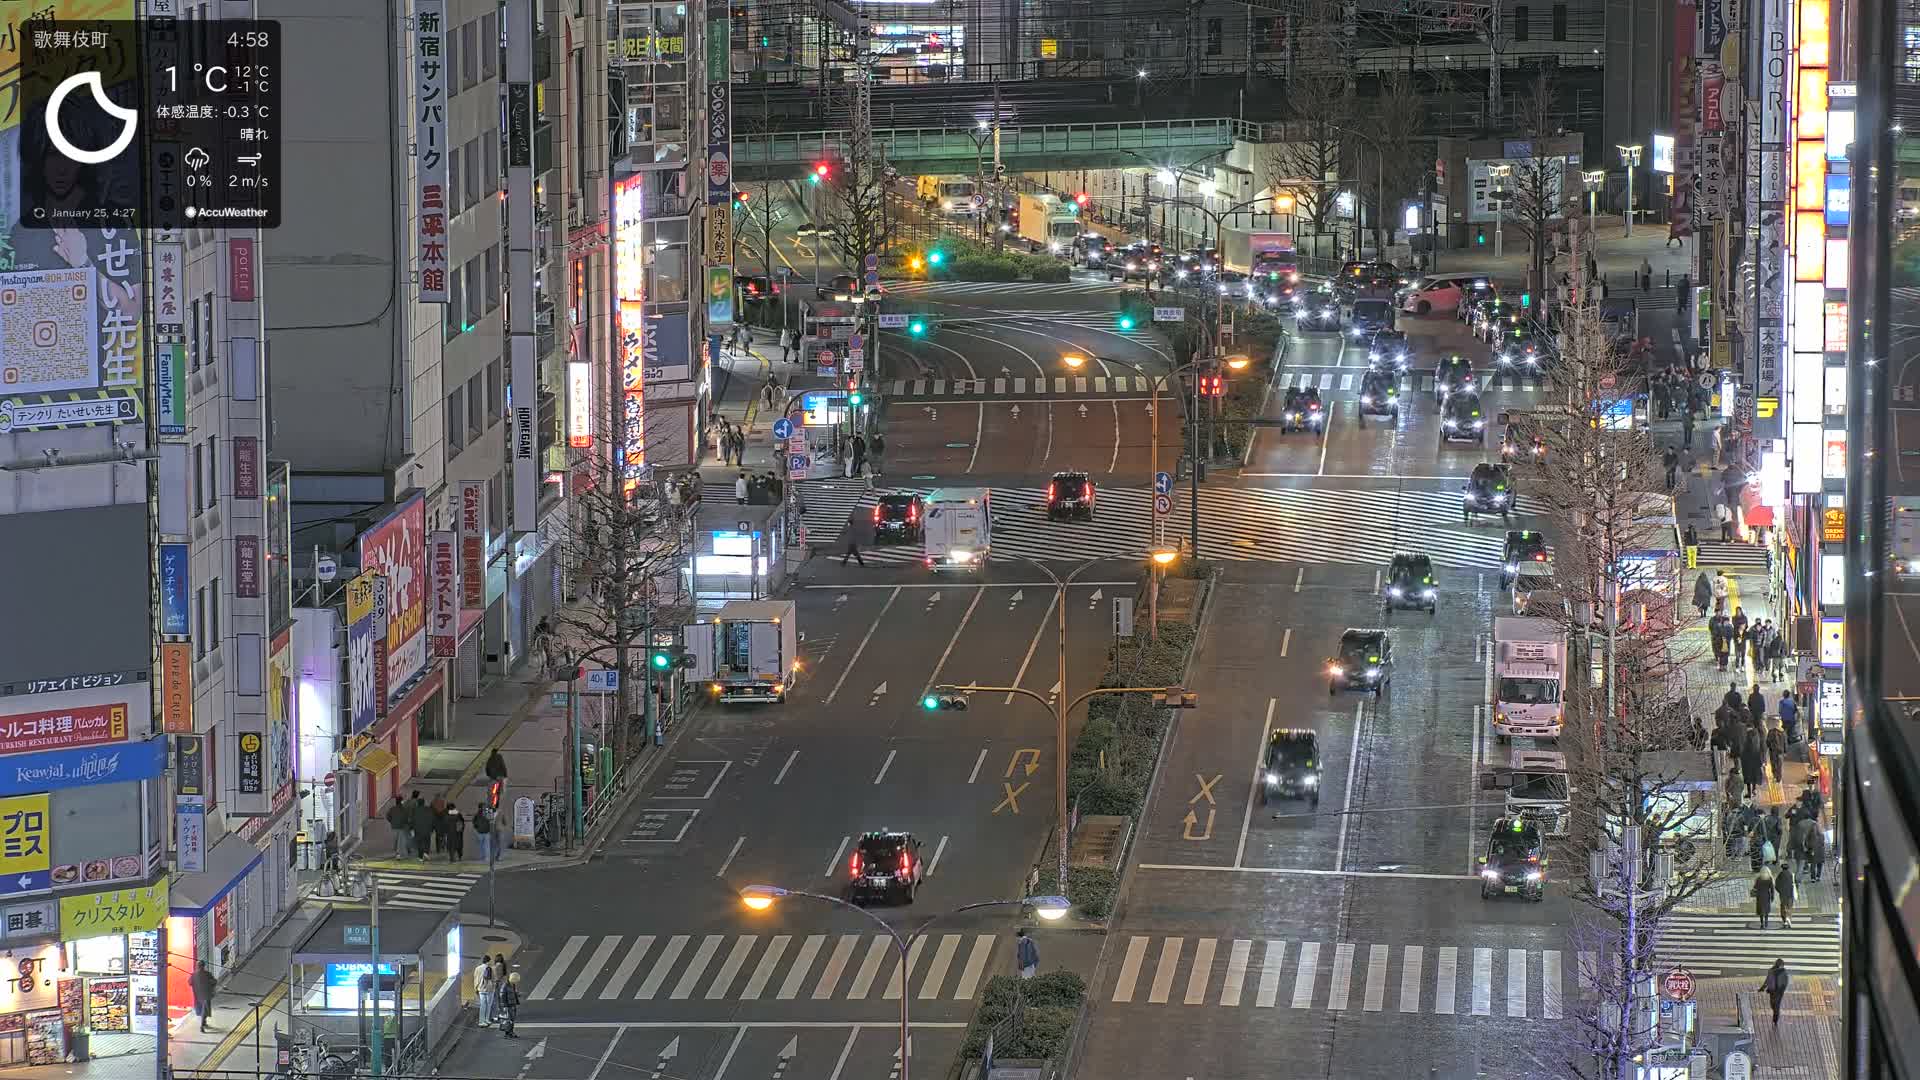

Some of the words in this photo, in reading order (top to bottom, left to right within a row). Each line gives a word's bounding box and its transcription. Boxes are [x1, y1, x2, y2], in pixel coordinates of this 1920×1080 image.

[419, 12, 441, 170] 新宿サンパーク
[1708, 88, 1720, 120] アコム
[711, 87, 725, 138] もつなべ
[713, 208, 726, 263] 肉汁水餃子
[0, 275, 44, 288] Instagram
[1761, 330, 1775, 382] 大衆酒場
[160, 353, 173, 414] FamilyMart
[17, 409, 52, 422] テンクリ
[57, 405, 115, 420] たいせい先生
[517, 407, 530, 459] HOMEGAME
[464, 487, 475, 530] GAME
[165, 554, 176, 605] ゲウチャイ
[28, 677, 80, 693] リアエイド
[82, 673, 123, 688] ビジョン
[28, 734, 73, 747] RESTAURANT
[4, 810, 43, 836] プロ
[4, 835, 43, 858] ミス
[8, 911, 43, 931] 囲碁
[73, 903, 145, 927] クリスタル
[1667, 980, 1689, 990] 消火栓
